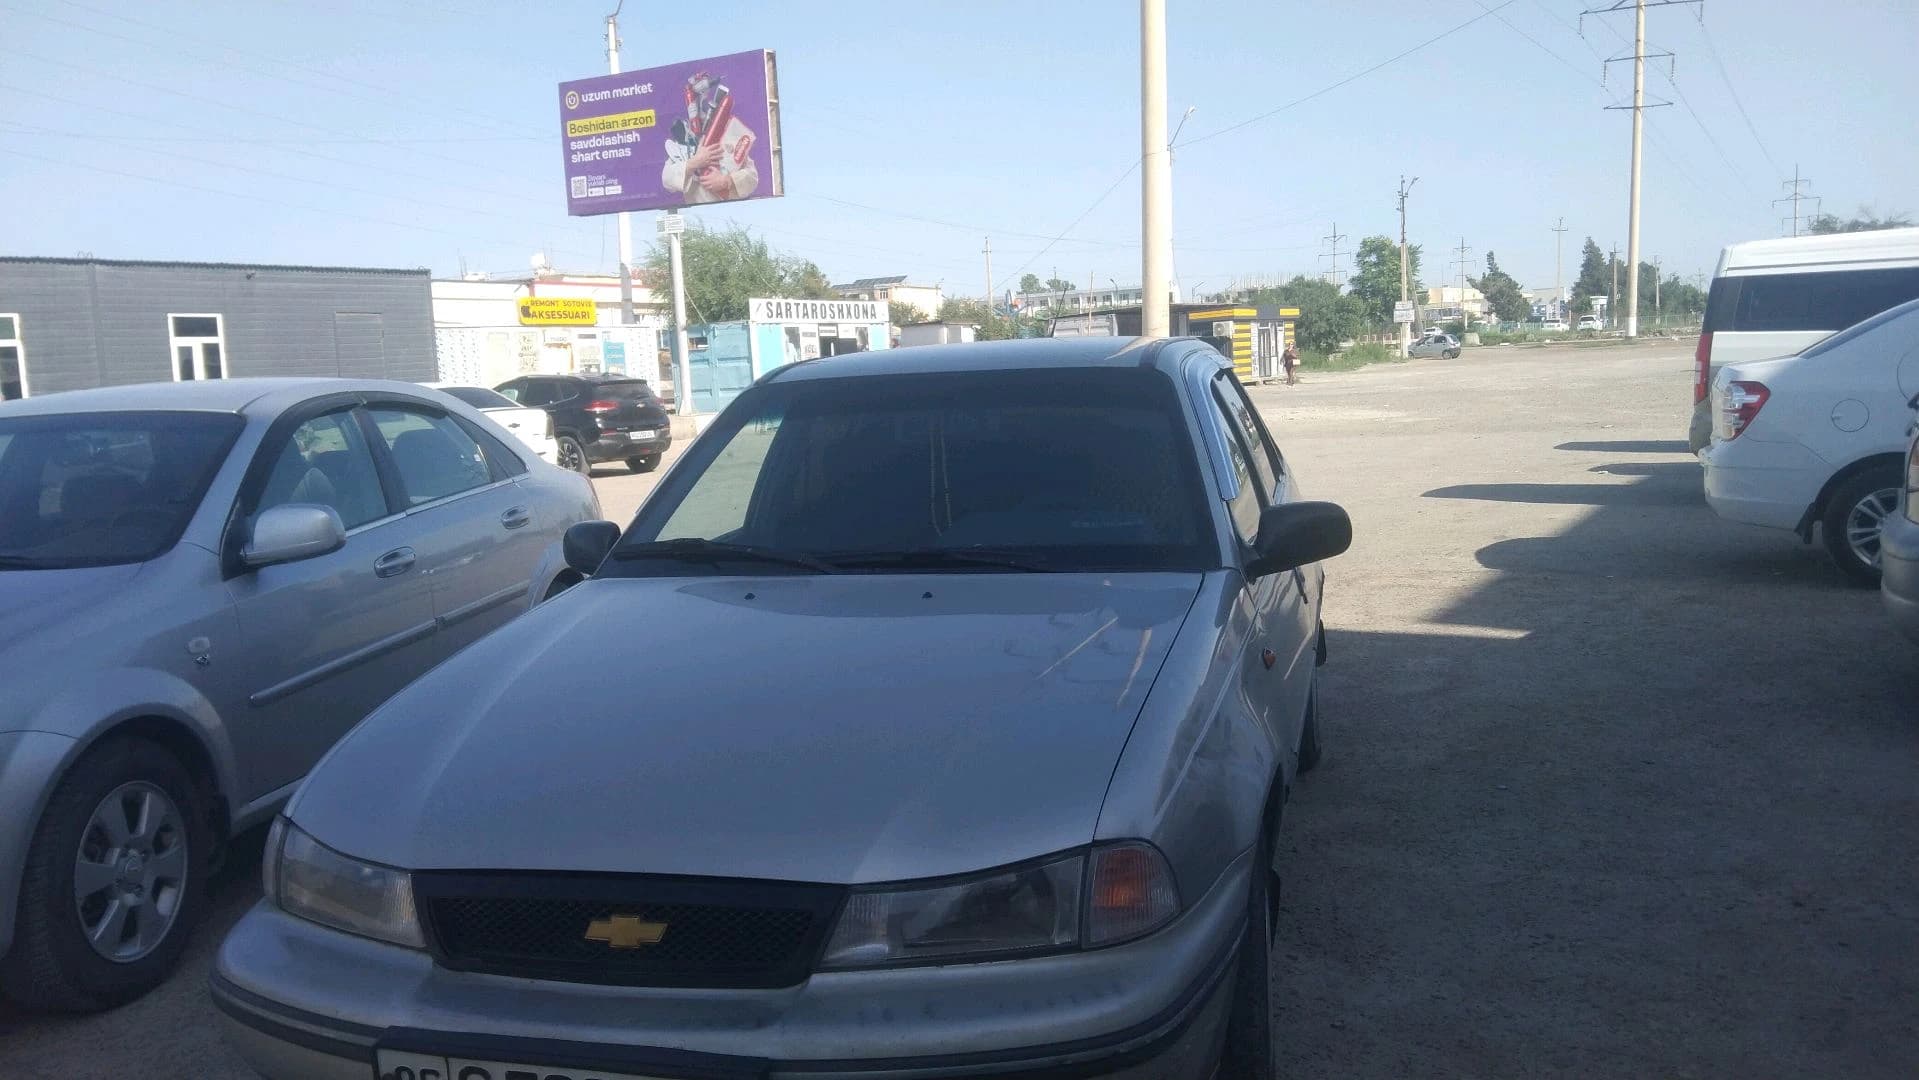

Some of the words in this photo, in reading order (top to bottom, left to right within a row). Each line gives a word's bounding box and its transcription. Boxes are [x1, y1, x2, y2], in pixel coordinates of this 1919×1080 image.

[581, 91, 611, 102] uzum
[612, 83, 654, 98] market
[569, 119, 620, 134] Boshidan
[621, 115, 653, 127] arzon
[570, 131, 641, 150] savdolashish
[571, 150, 601, 163] shart
[602, 147, 632, 159] emas
[531, 311, 590, 319] AKSESSUARI
[766, 301, 877, 319] SARTAROSHXONA
